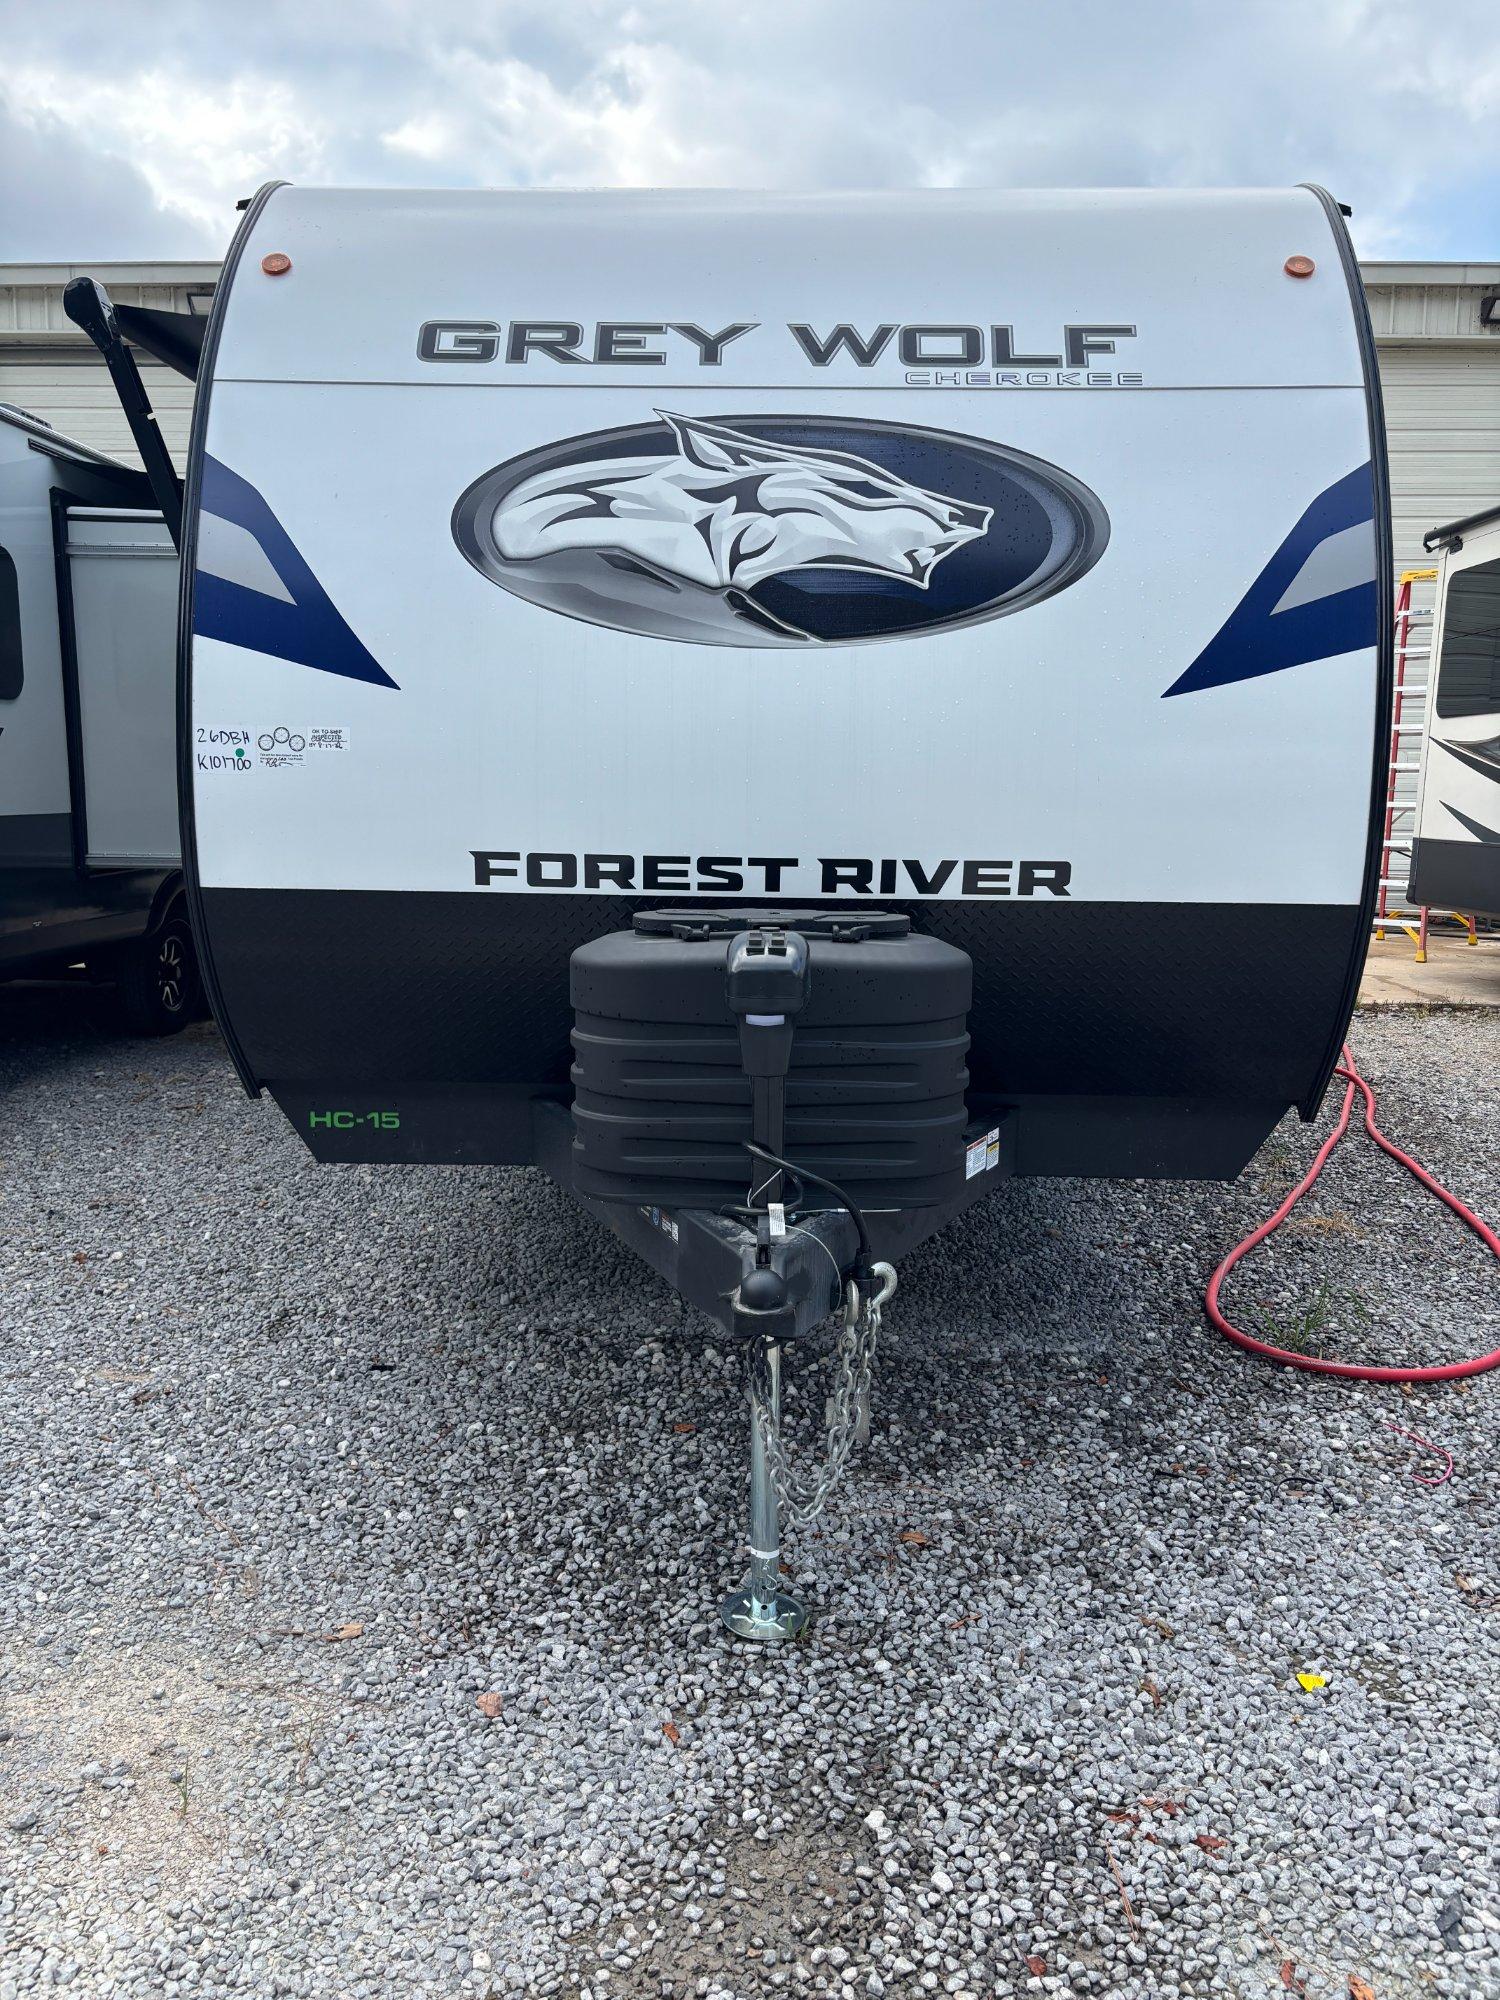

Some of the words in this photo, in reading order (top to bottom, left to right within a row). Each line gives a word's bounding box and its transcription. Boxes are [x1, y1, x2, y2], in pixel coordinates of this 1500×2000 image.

[416, 320, 762, 366] GREY
[786, 323, 1138, 369] WOLF
[905, 371, 1143, 386] CHEROKEE
[197, 728, 250, 745] 26DBH
[468, 850, 799, 893] FOREST
[816, 857, 1072, 897] RIVER
[309, 1111, 400, 1129] HC-15
